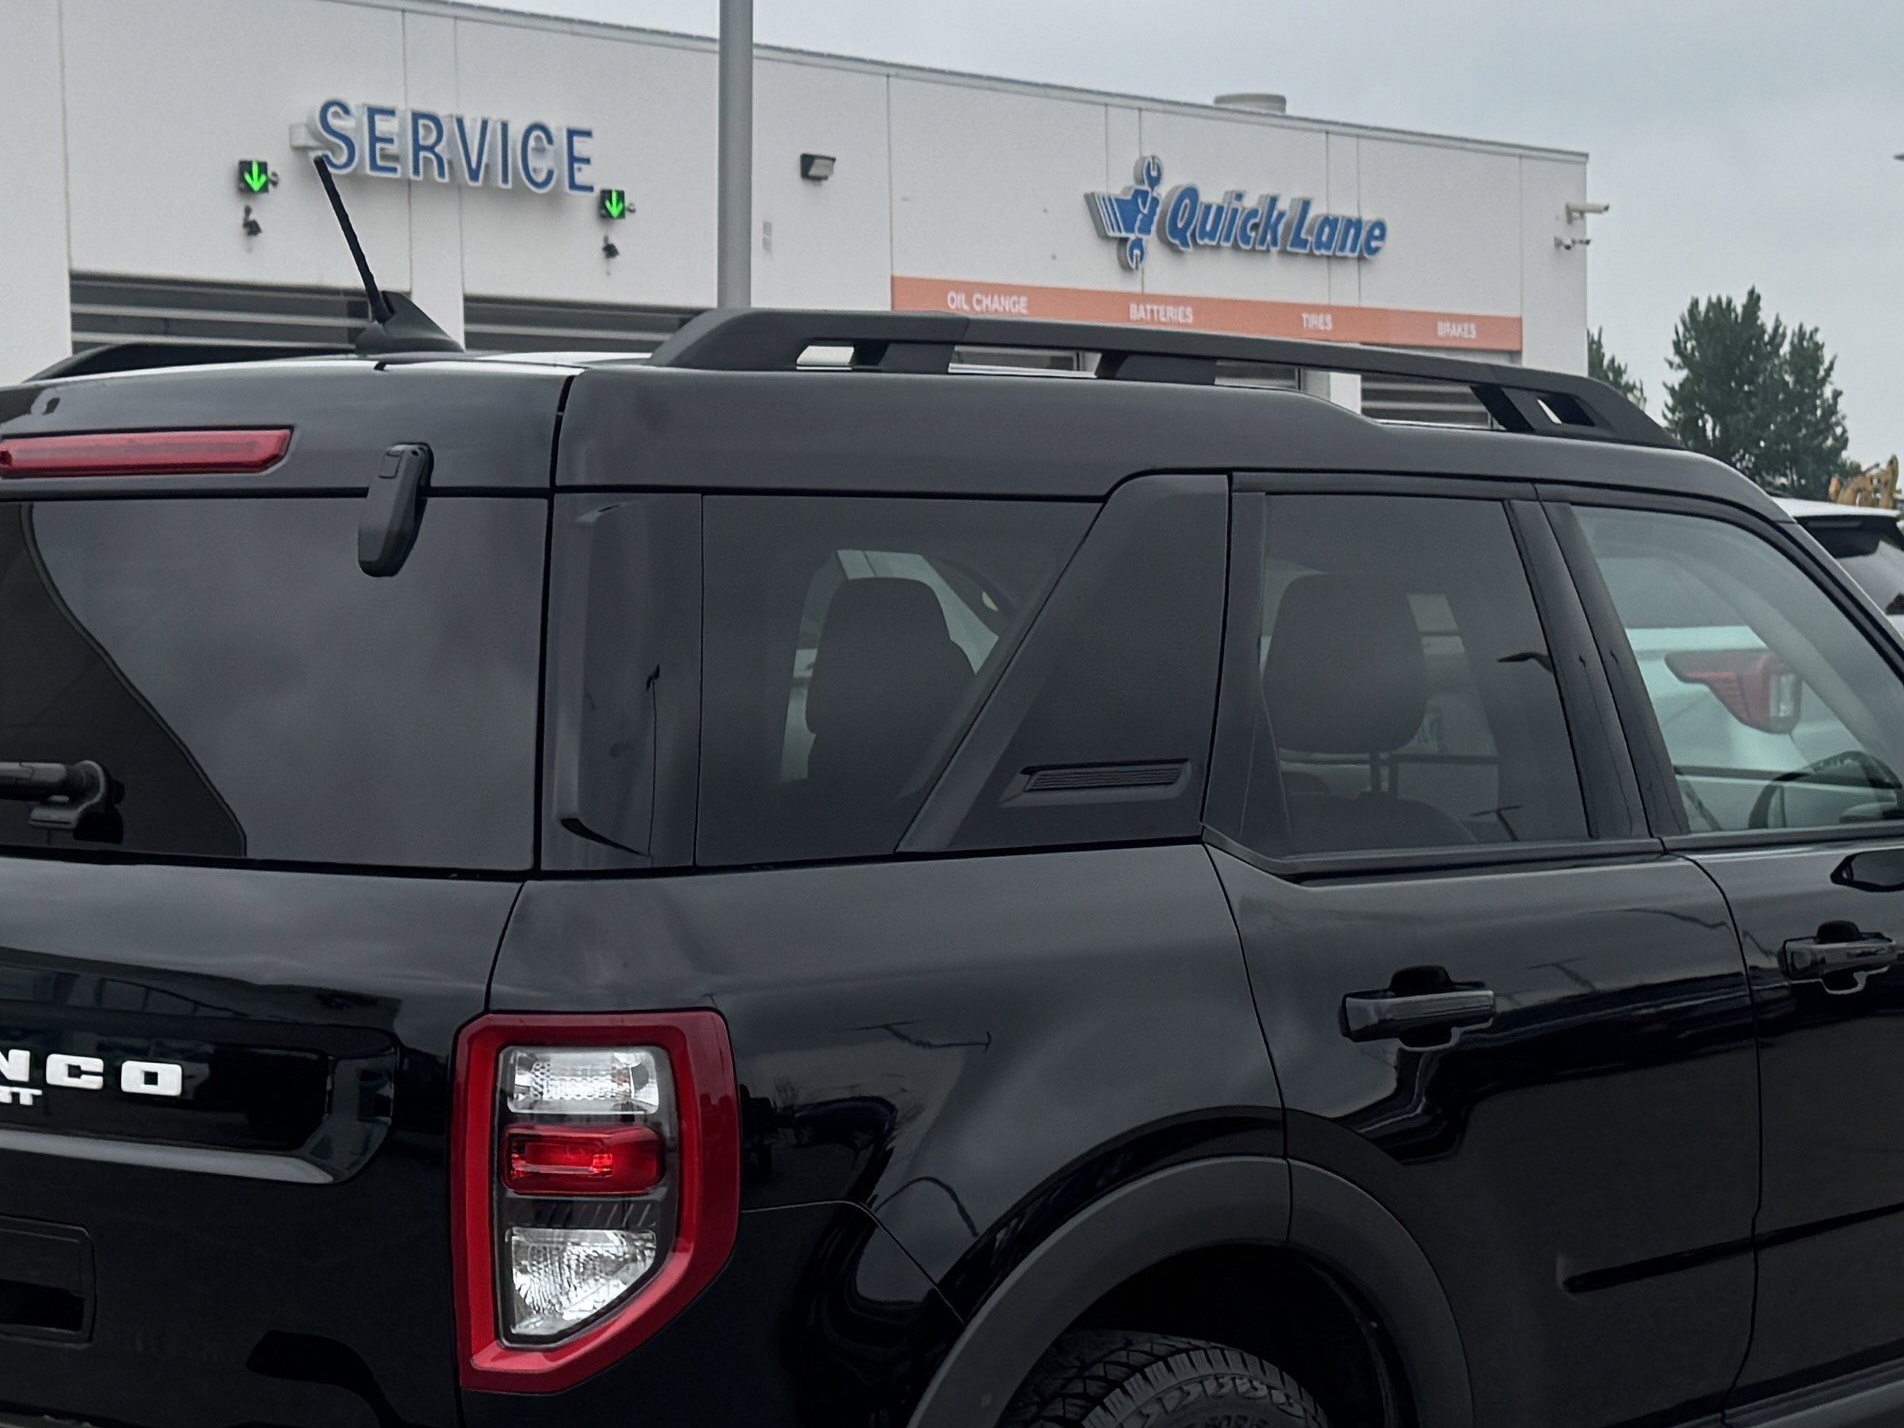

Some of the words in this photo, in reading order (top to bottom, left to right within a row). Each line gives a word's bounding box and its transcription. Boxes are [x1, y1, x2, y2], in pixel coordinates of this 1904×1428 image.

[317, 98, 595, 194] SERVICE
[947, 291, 969, 311] OIL
[973, 292, 1028, 314] CHANGE
[1130, 303, 1193, 323] BATTERIES
[1302, 312, 1332, 331] TIRES
[1437, 321, 1476, 339] BRAKES
